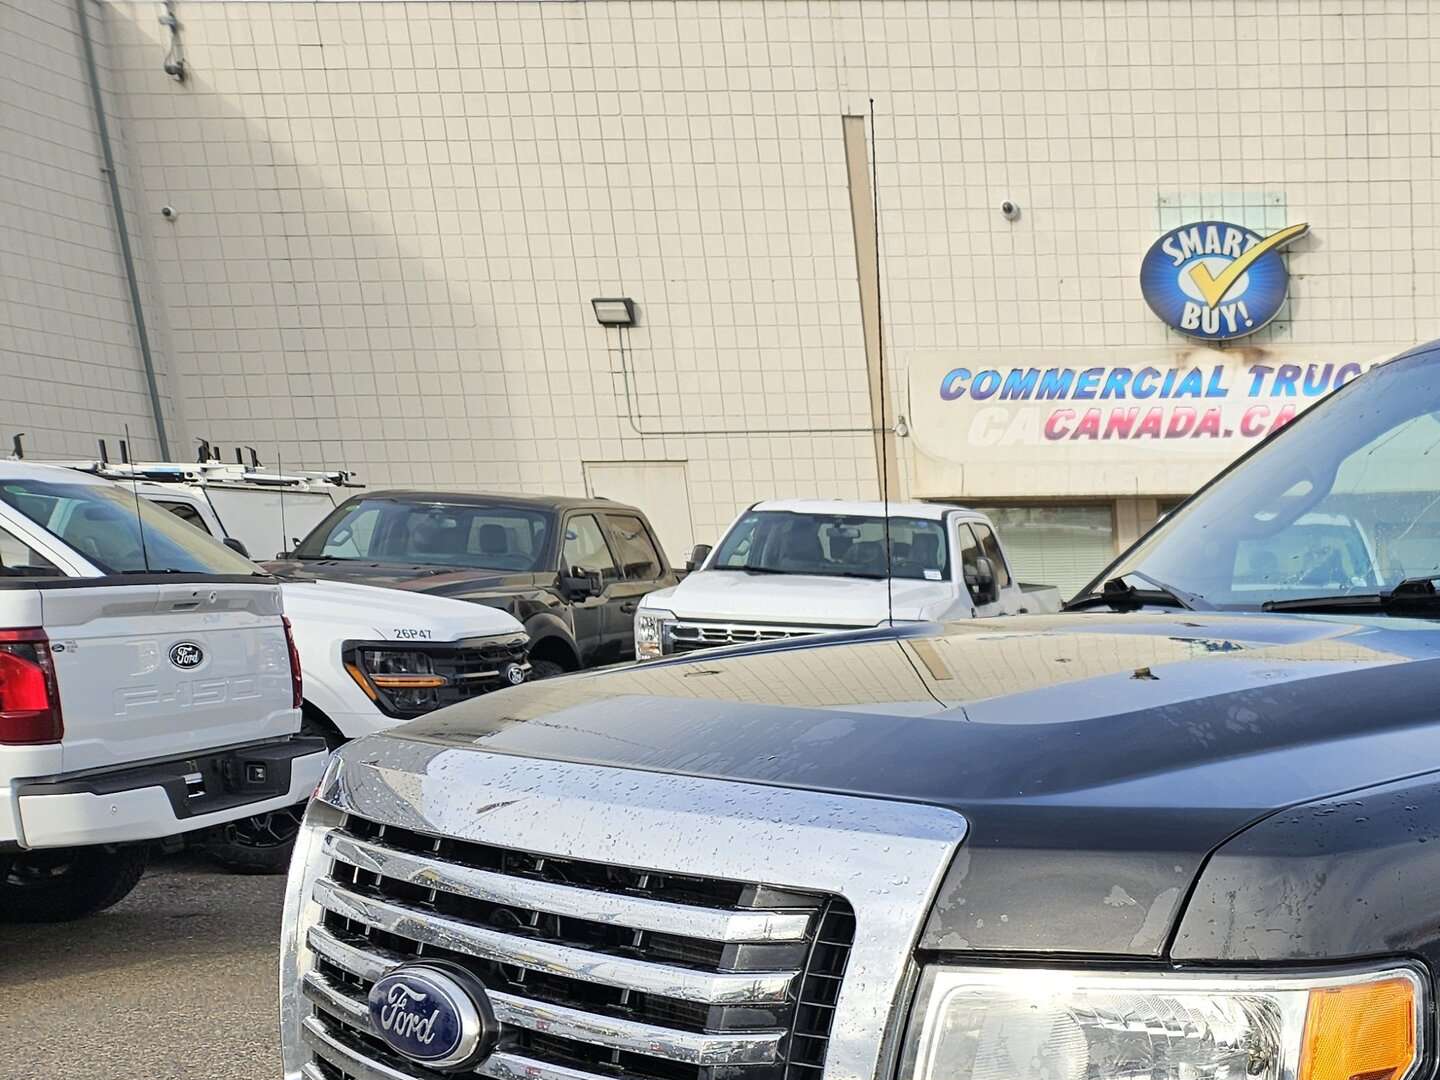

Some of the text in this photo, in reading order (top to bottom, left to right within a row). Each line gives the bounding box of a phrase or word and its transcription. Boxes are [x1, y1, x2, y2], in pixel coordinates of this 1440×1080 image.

[1161, 225, 1262, 267] SMART
[1180, 301, 1253, 334] BUY!
[939, 362, 1362, 401] COMMERCIAL TRUC
[1043, 404, 1296, 441] CANADA.CA
[394, 629, 431, 640] 26P47
[176, 646, 198, 664] Ford
[381, 983, 440, 1045] Ford
